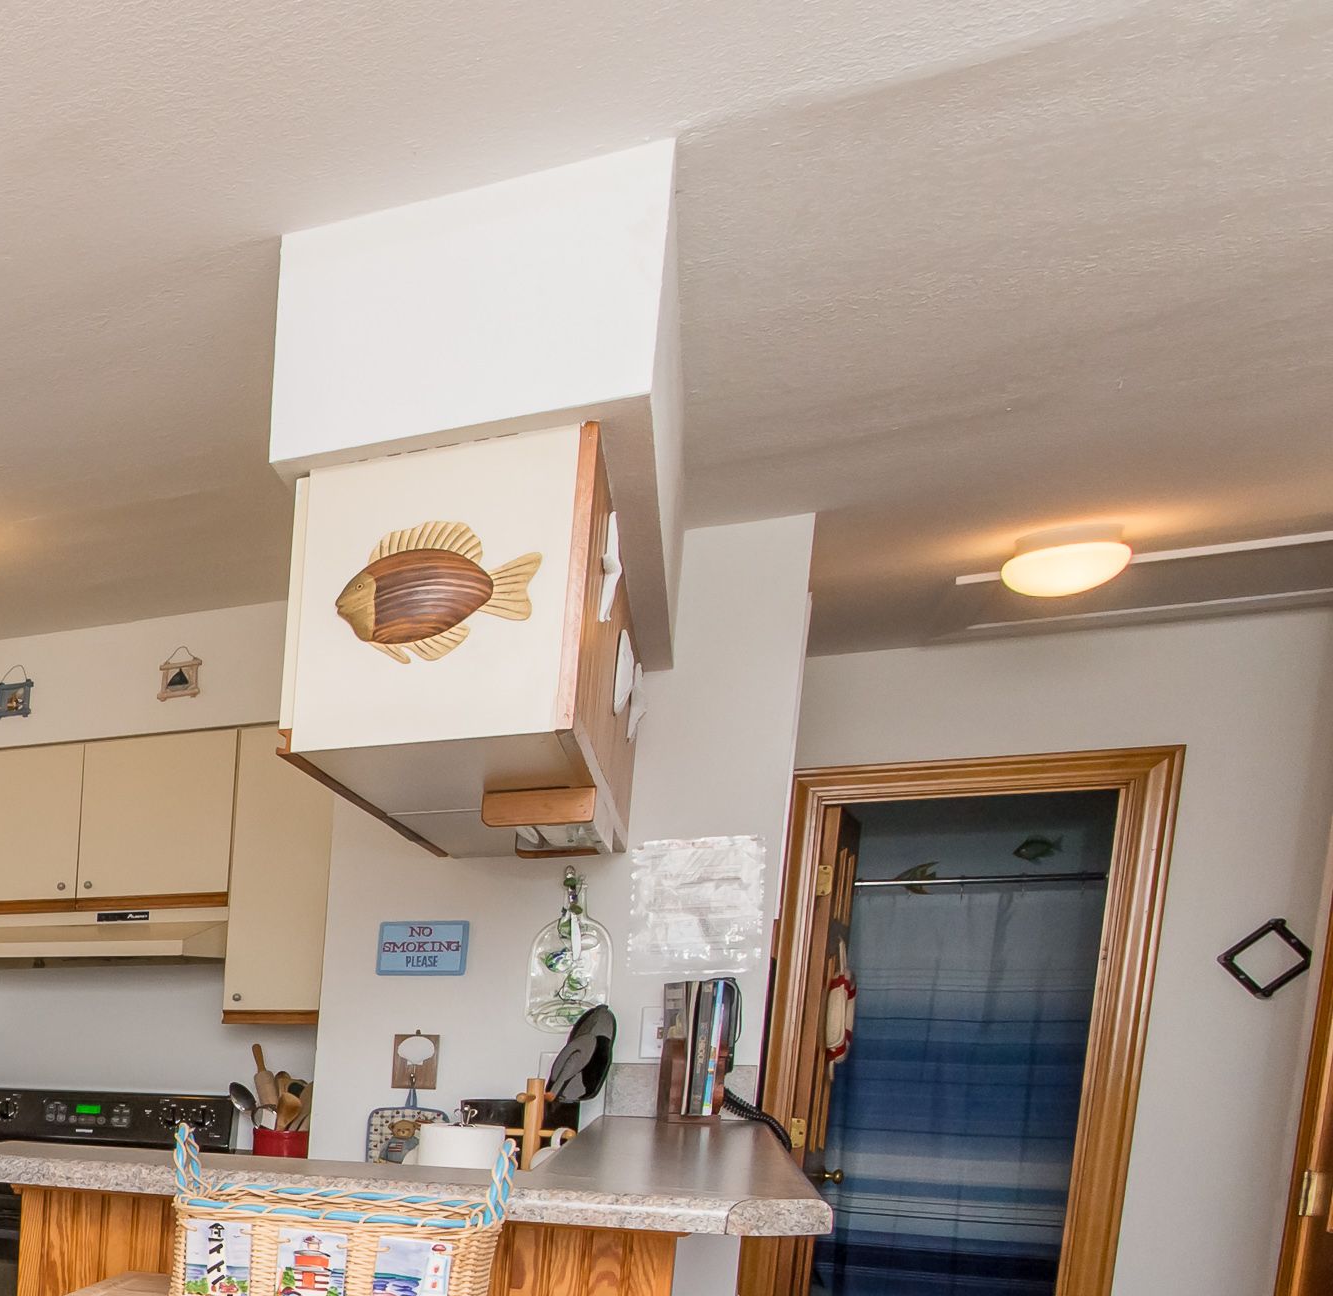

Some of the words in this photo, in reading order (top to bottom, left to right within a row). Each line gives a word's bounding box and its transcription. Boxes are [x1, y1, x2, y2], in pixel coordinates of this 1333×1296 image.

[409, 926, 433, 937] NO
[382, 941, 462, 953] SMOKING
[405, 955, 439, 967] PLEASE
